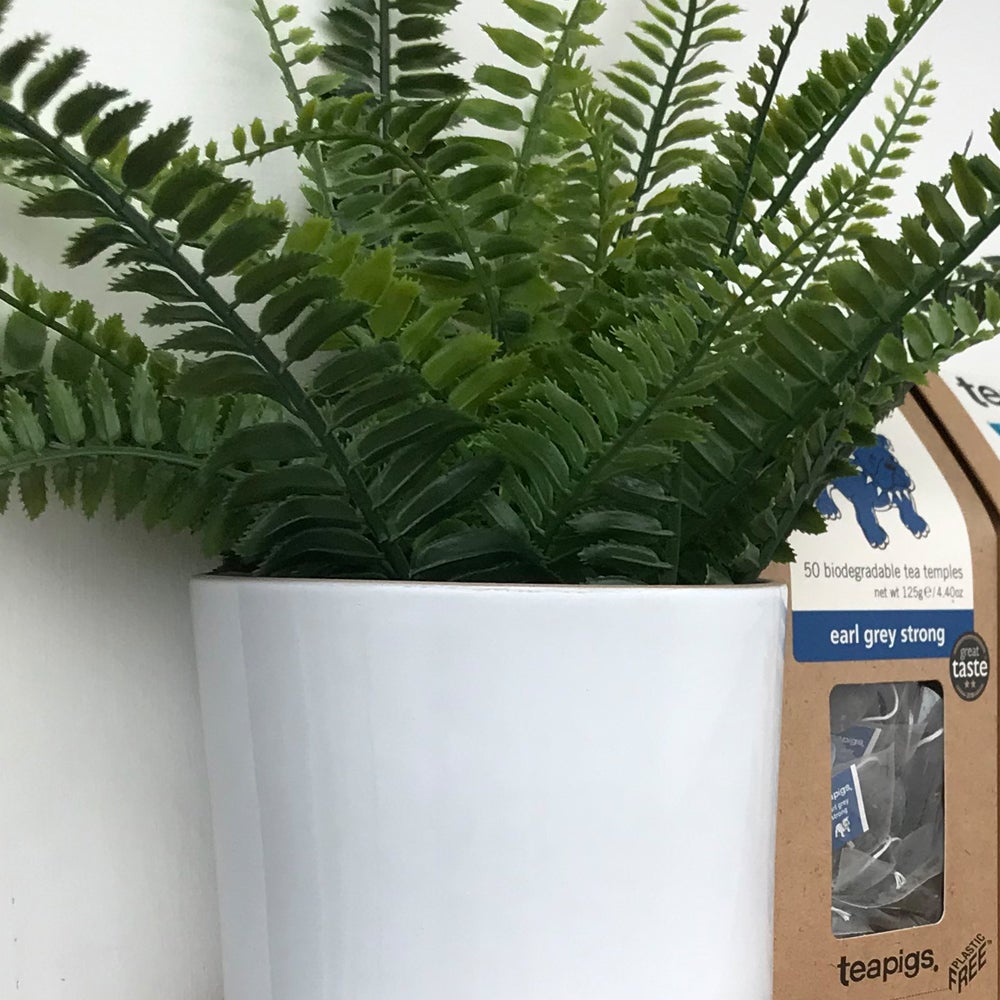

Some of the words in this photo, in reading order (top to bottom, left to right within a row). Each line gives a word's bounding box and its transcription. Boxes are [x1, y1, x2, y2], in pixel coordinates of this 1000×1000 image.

[803, 561, 820, 578] 50
[824, 562, 901, 582] biodegradable
[904, 564, 920, 579] tea
[923, 564, 964, 581] temples
[874, 587, 887, 598] net
[890, 587, 900, 598] wt
[830, 623, 860, 645] earl
[864, 629, 896, 649] grey
[900, 625, 945, 647] strong
[960, 646, 980, 661] great
[952, 658, 989, 678] taste
[951, 933, 986, 970] PLASTIC
[837, 949, 939, 987] teapigs.
[948, 940, 987, 994] FREE
